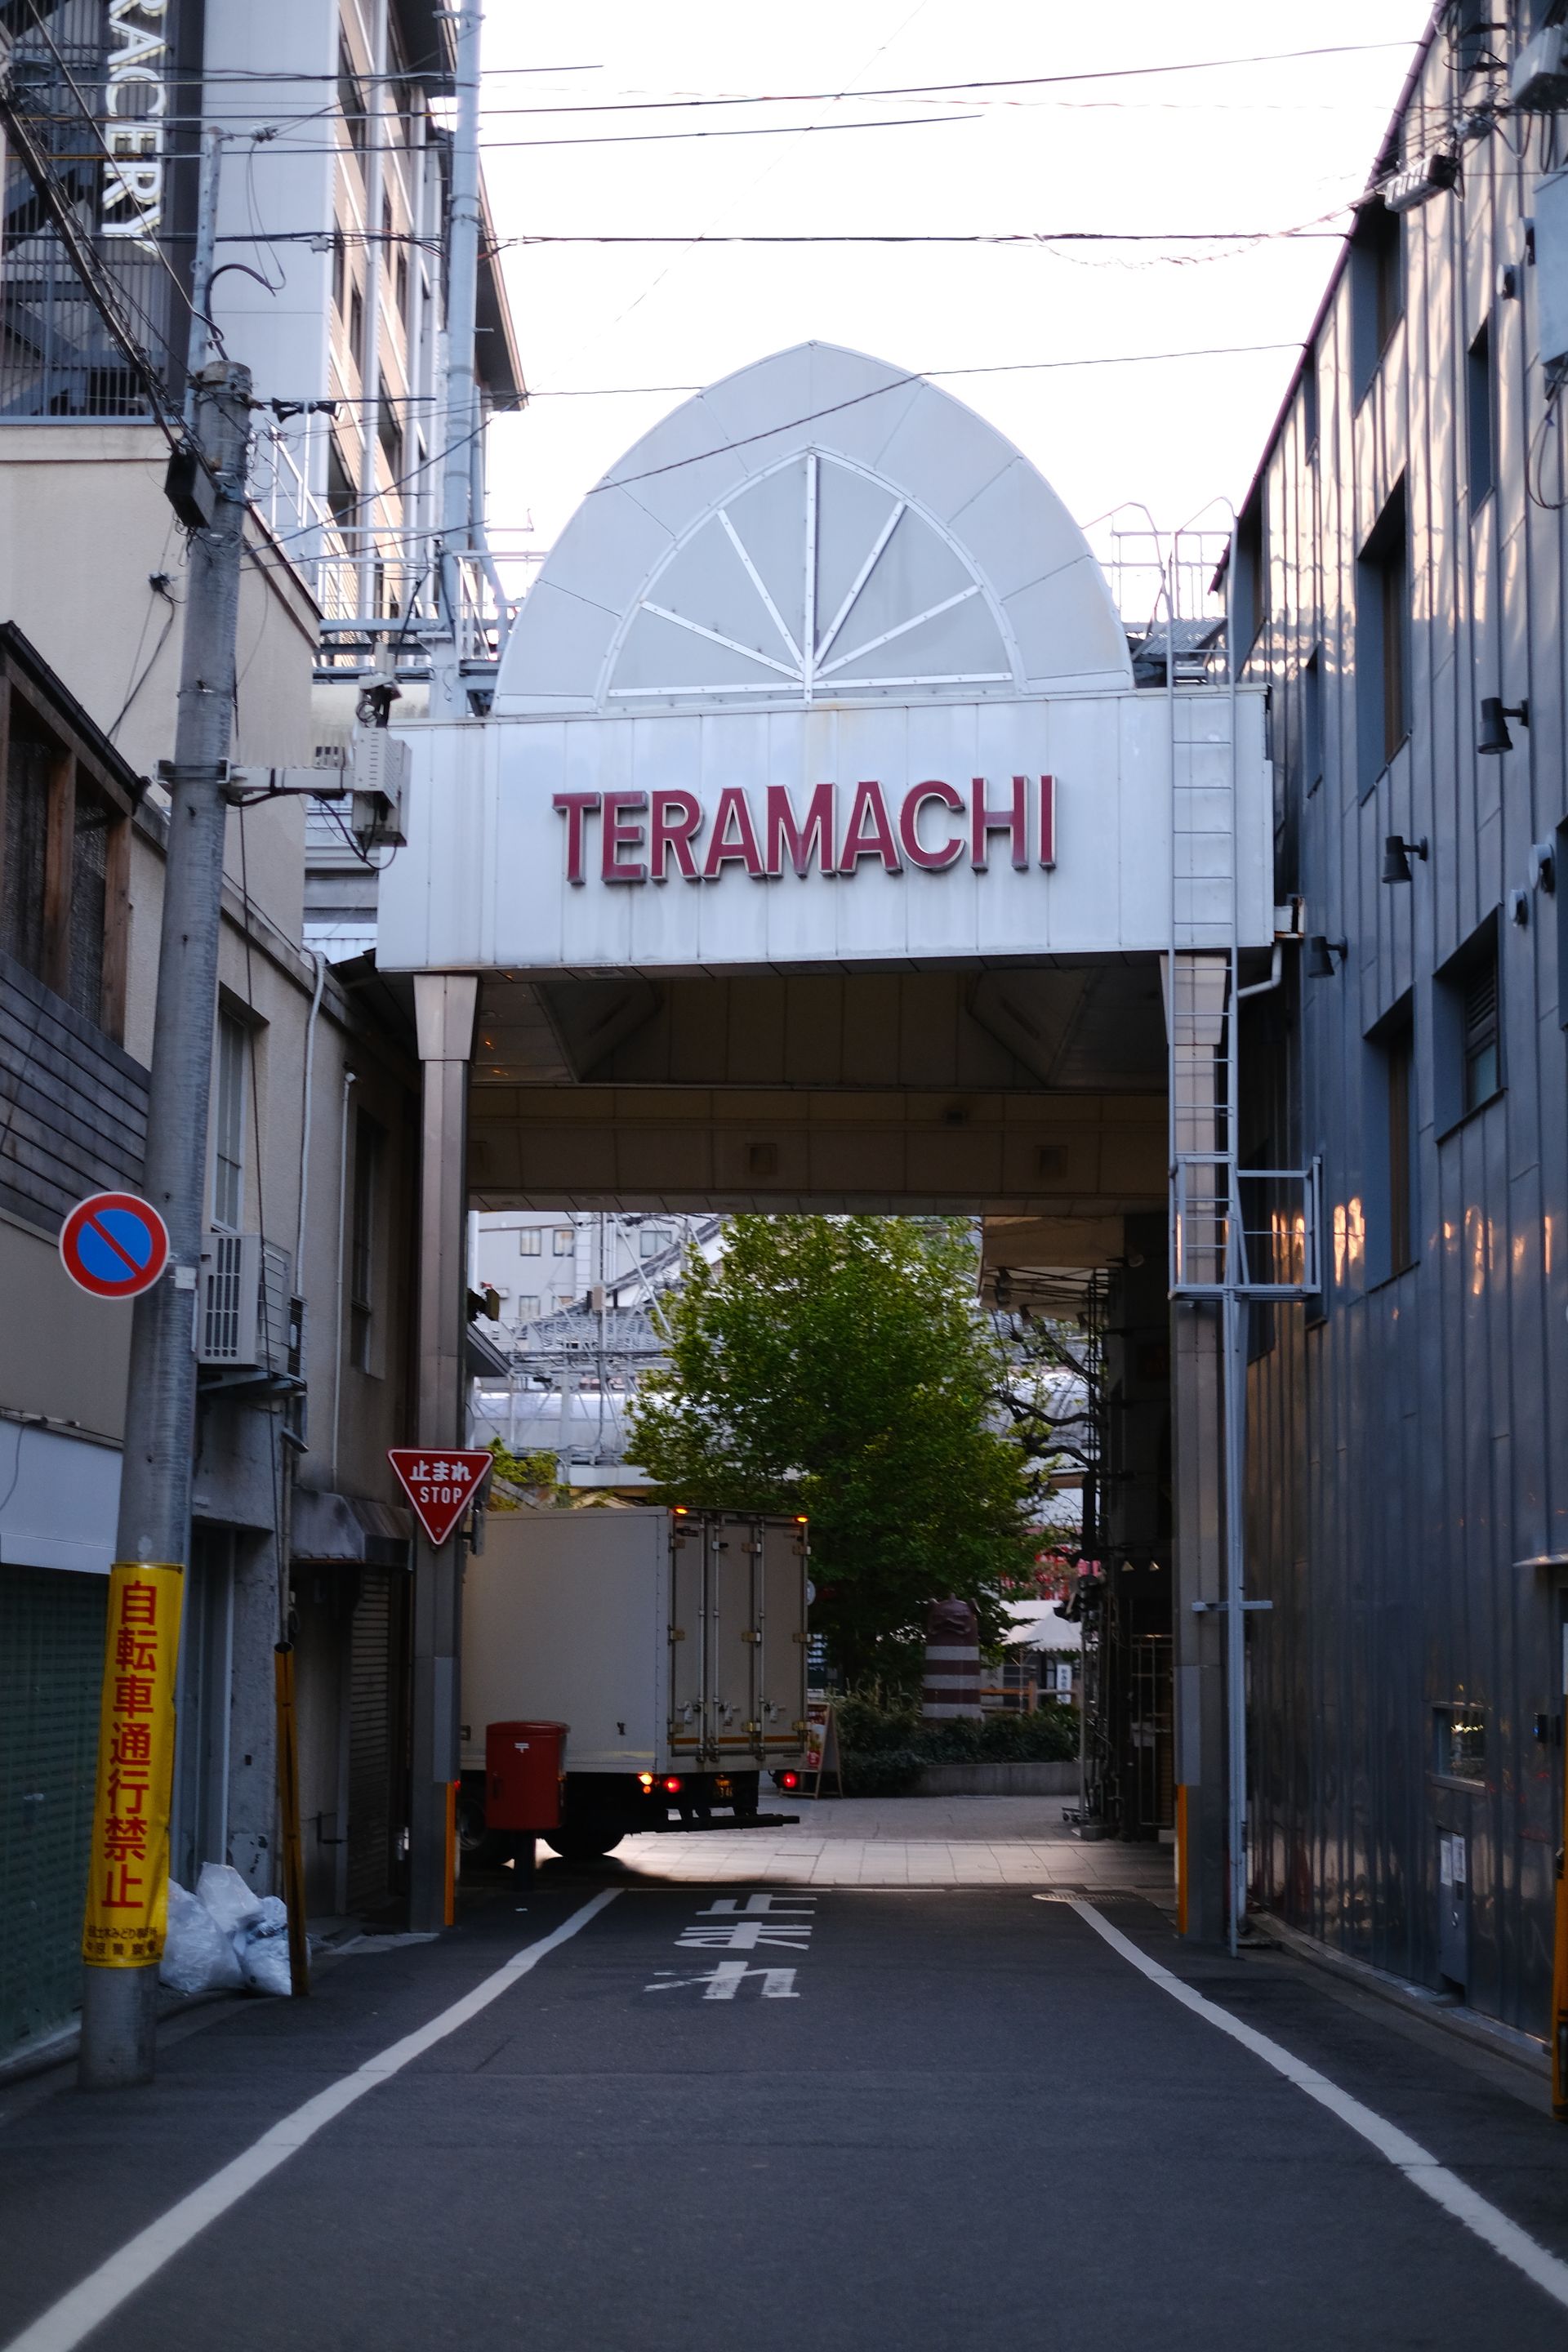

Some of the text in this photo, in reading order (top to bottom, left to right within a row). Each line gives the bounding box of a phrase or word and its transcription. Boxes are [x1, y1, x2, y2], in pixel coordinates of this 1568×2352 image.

[552, 774, 1057, 885] TERAMACHI
[409, 1459, 472, 1482] 止まれ
[419, 1486, 462, 1504] STOP
[101, 1579, 158, 1910] 自転車通行禁止
[643, 1893, 817, 2000] 止まれ
